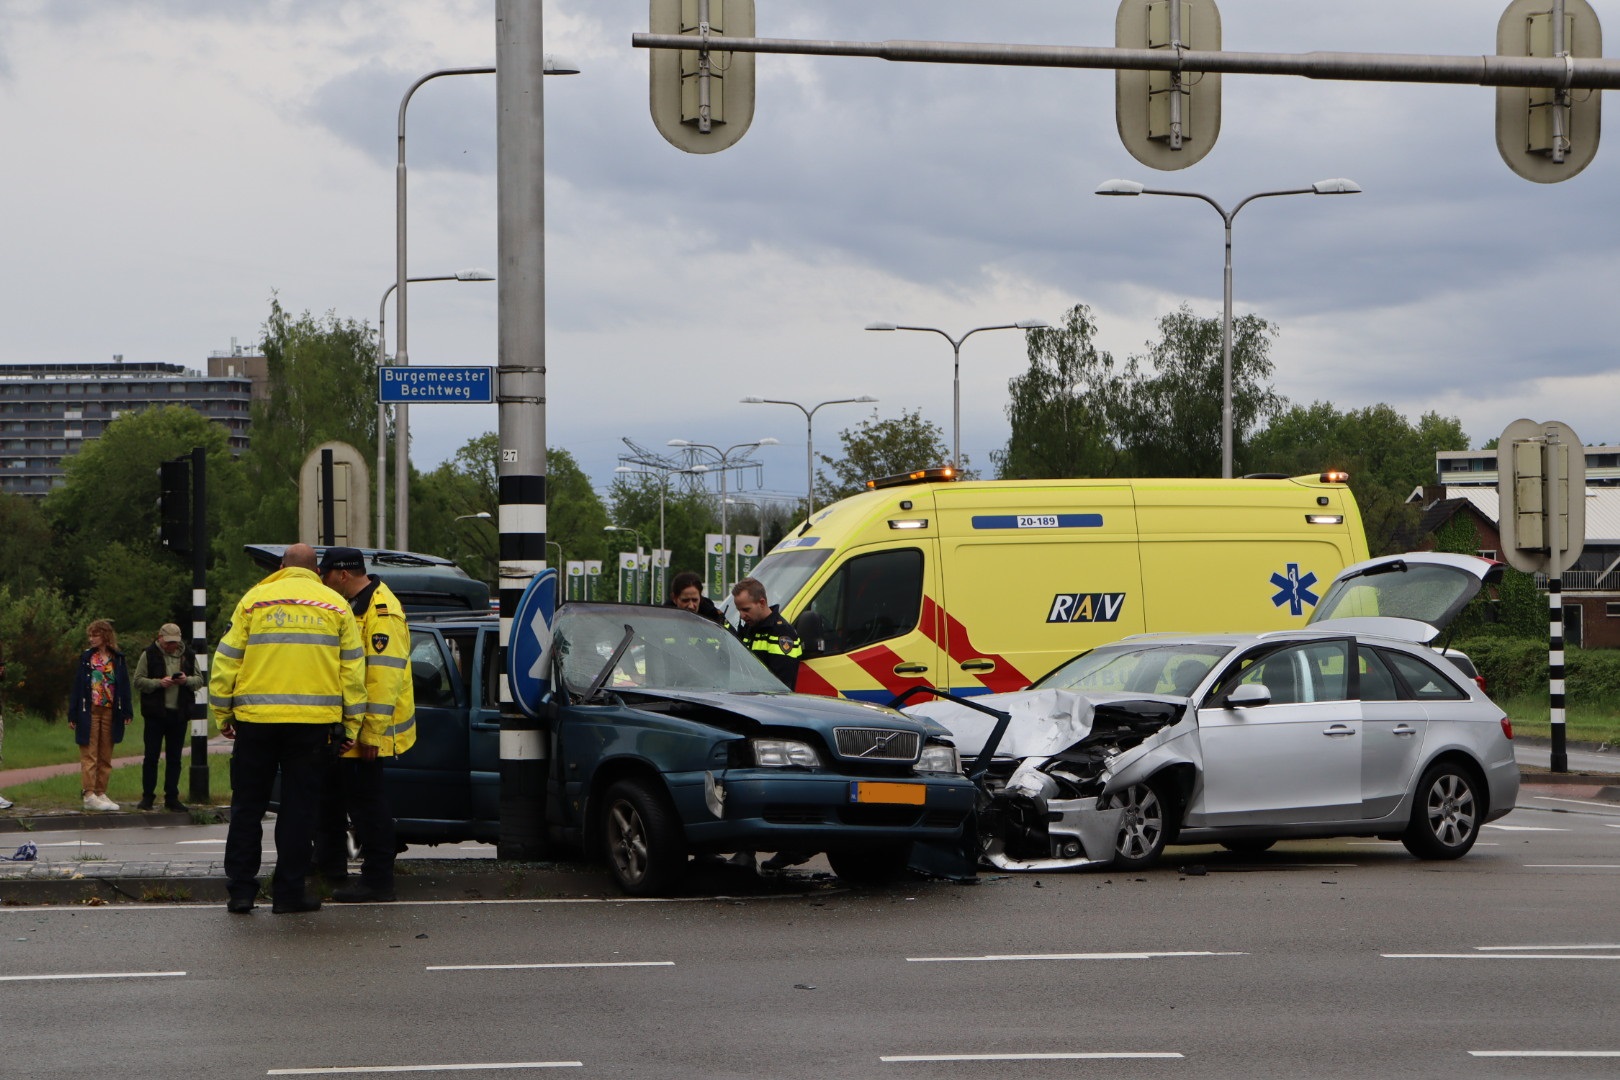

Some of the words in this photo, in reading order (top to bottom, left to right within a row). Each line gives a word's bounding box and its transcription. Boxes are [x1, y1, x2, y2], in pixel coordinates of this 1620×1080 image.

[385, 370, 485, 384] Burgemeester
[401, 384, 471, 398] Bechtweg
[503, 451, 517, 461] 27
[1020, 517, 1056, 526] 20-189
[1049, 594, 1124, 621] RAV
